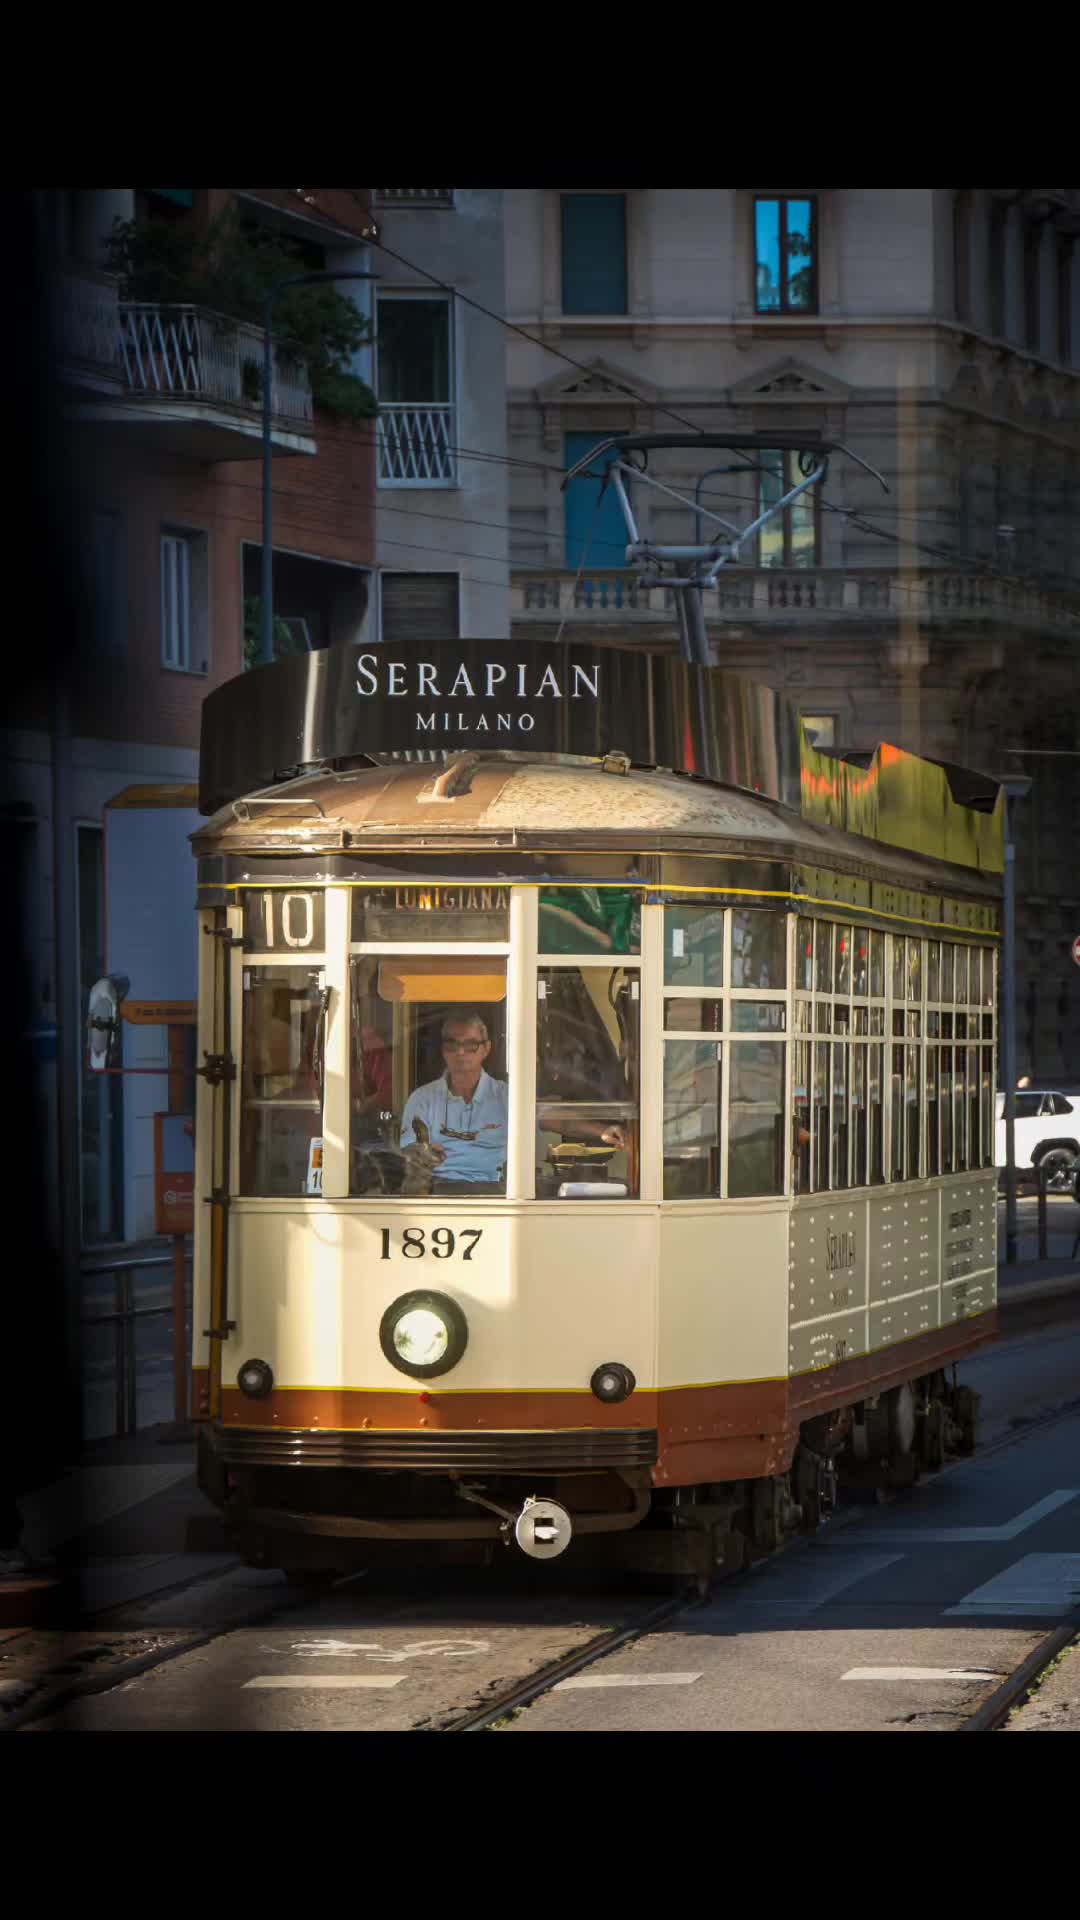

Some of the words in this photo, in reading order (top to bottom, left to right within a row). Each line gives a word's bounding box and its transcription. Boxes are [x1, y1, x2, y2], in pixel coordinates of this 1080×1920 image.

[355, 653, 601, 698] SERAPIAN
[415, 713, 535, 732] MILANO
[395, 886, 508, 911] LUNIGIANA
[263, 890, 314, 947] 10
[379, 1227, 483, 1261] 1897
